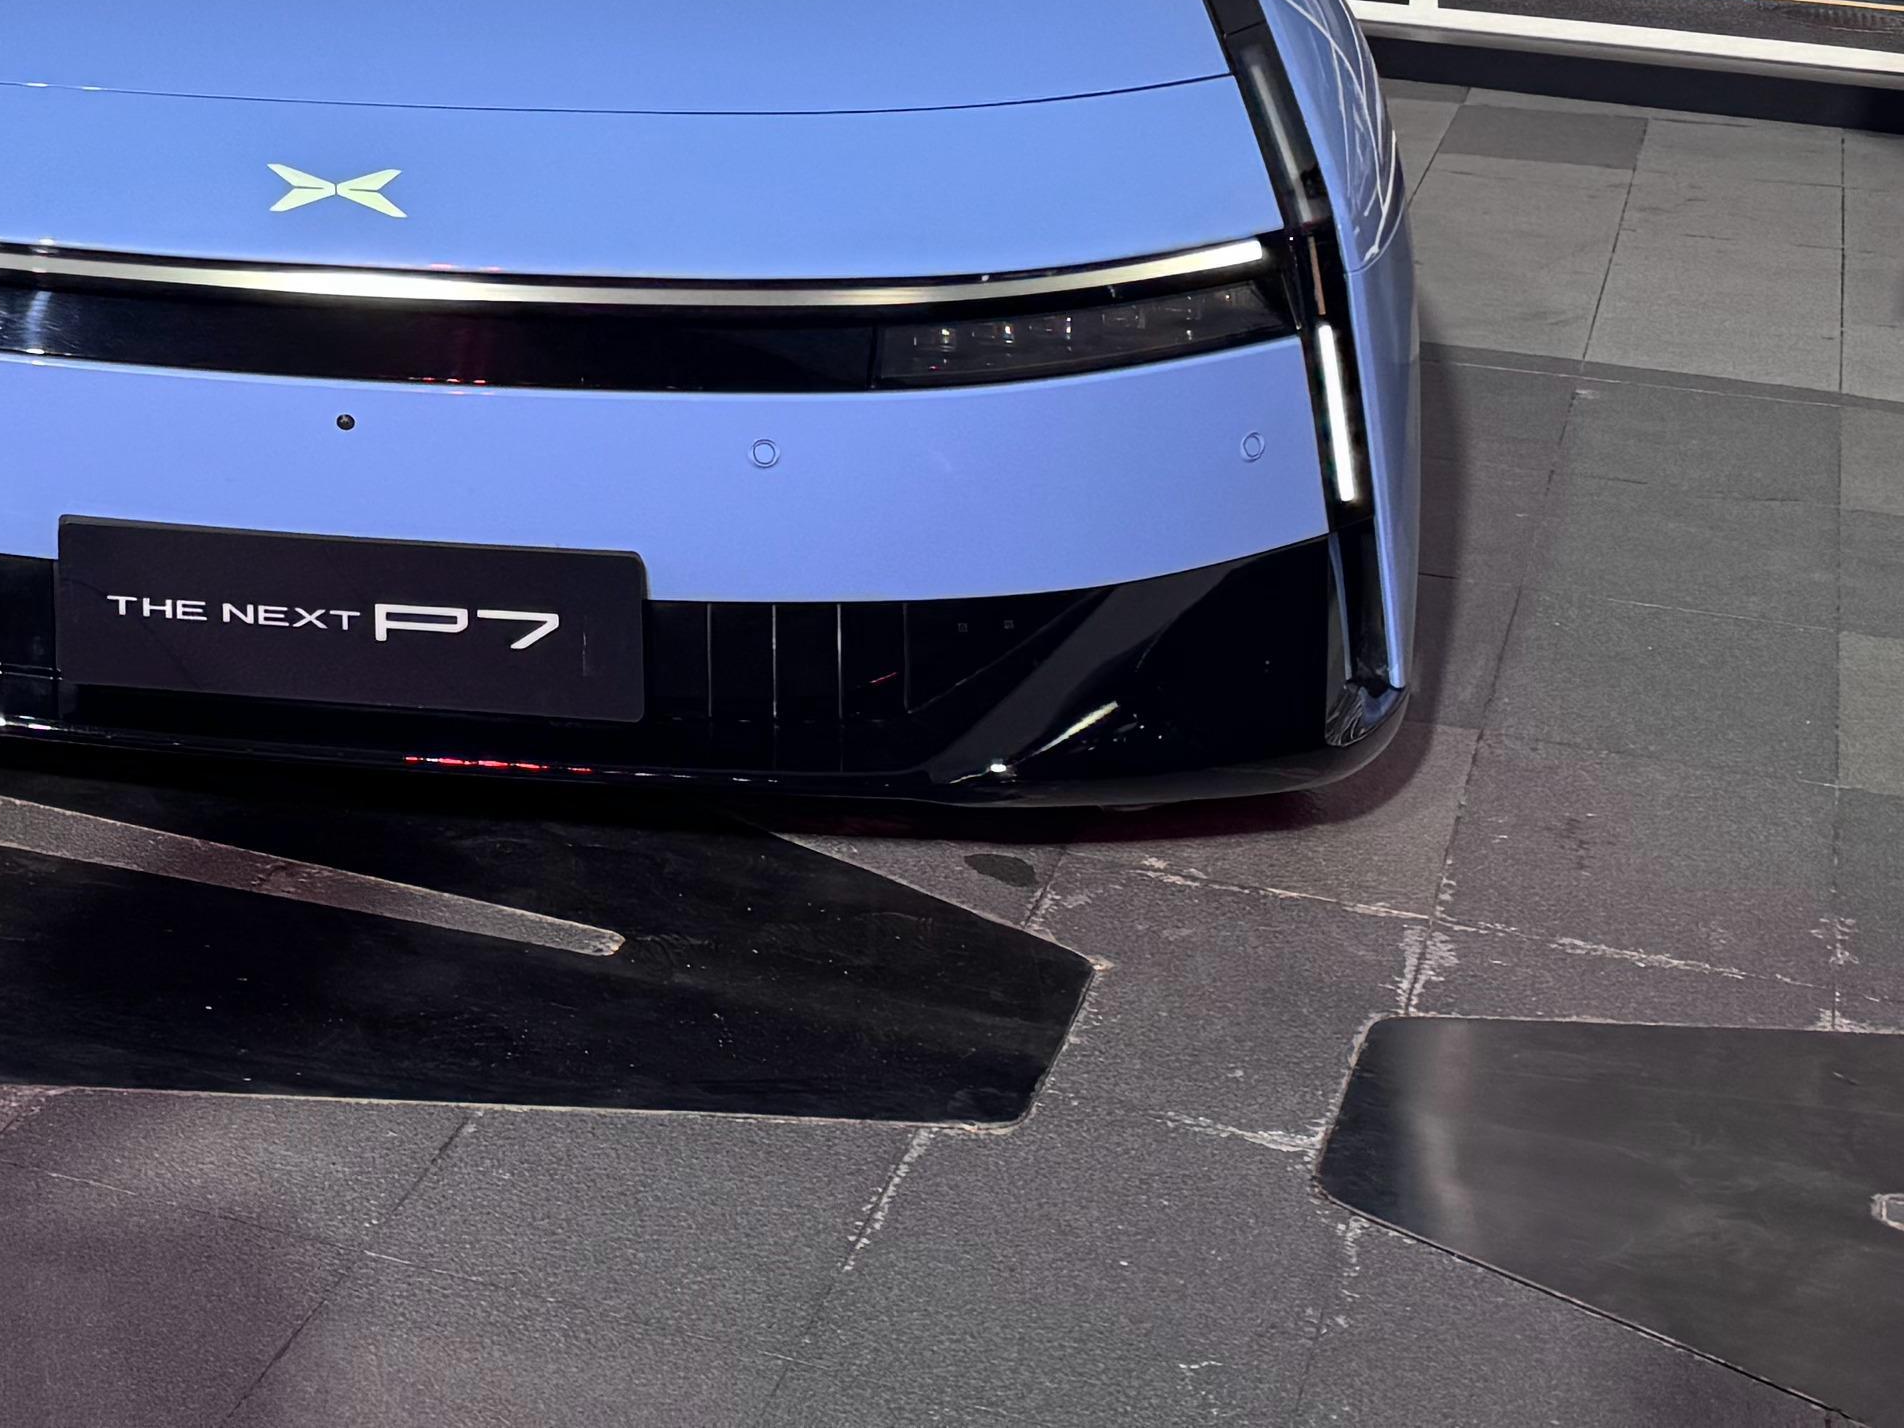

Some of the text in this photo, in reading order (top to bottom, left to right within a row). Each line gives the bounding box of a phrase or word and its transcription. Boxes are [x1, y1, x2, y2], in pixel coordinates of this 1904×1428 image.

[106, 594, 560, 650] THE NEXT P7
